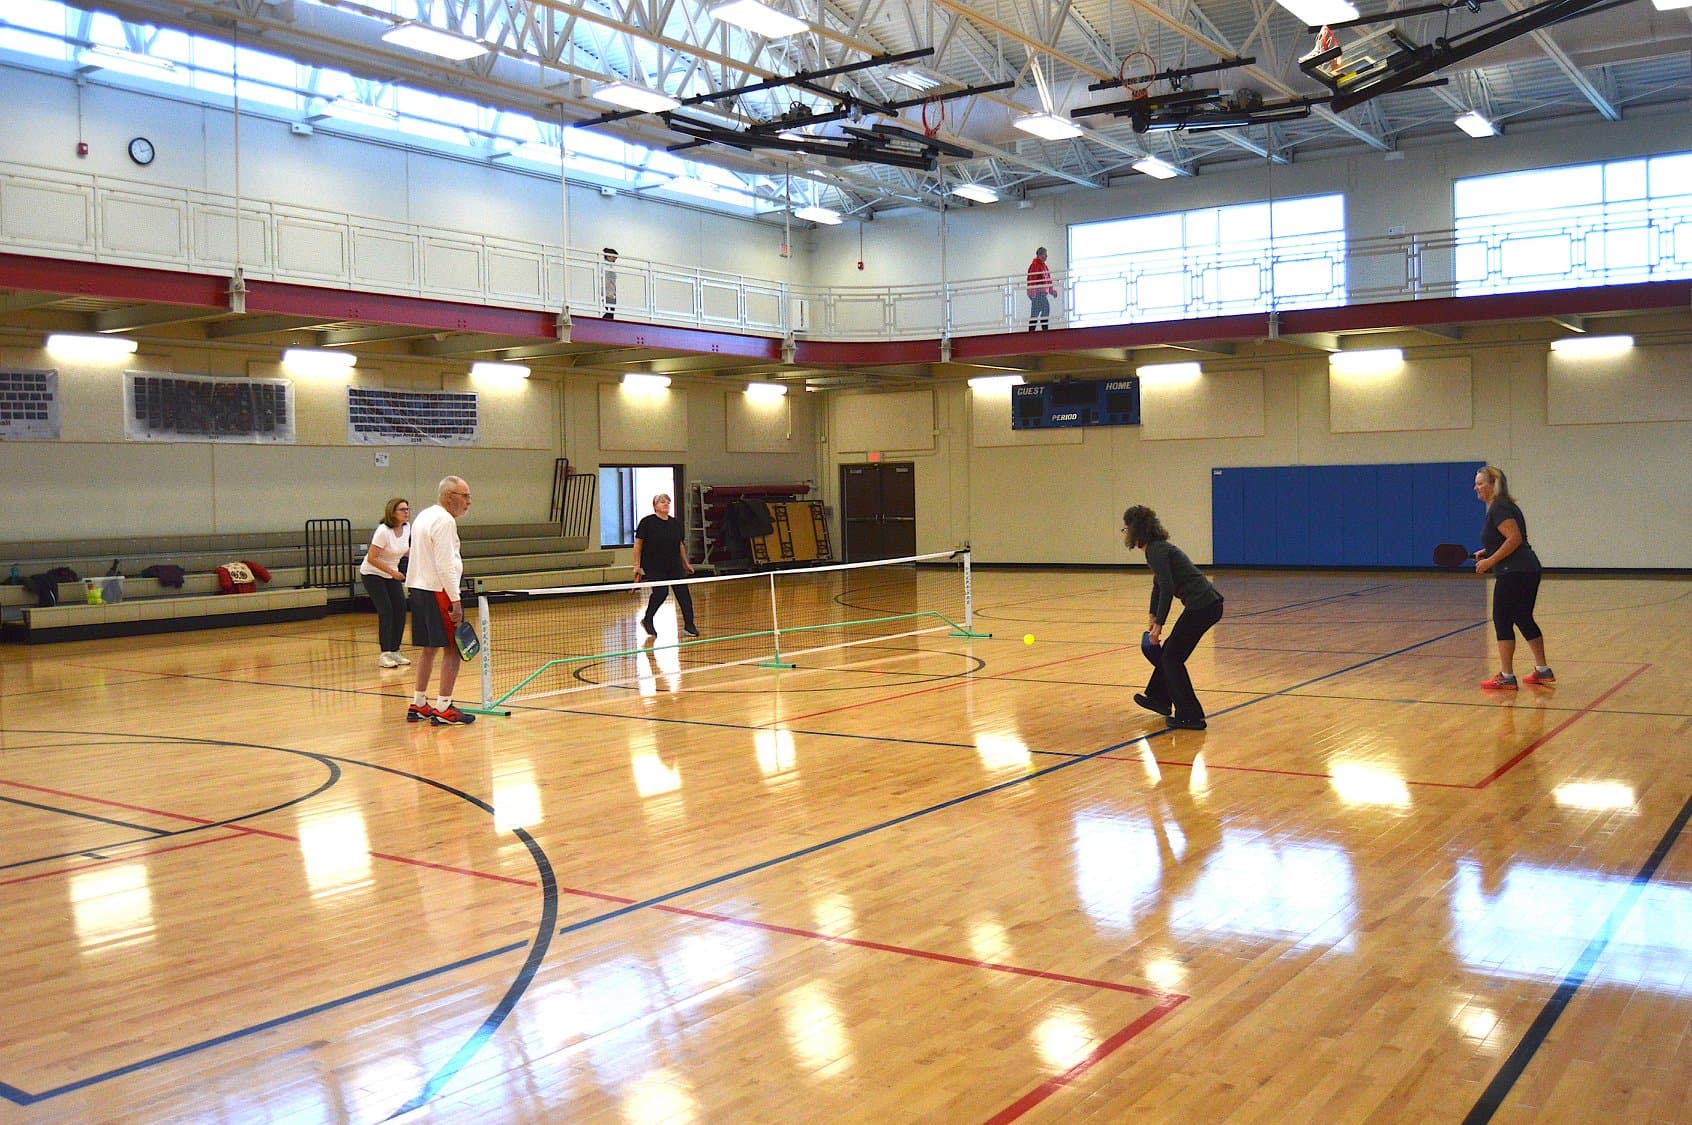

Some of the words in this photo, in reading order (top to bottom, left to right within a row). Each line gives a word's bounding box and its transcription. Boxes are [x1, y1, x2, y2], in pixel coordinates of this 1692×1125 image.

[1017, 386, 1045, 396] GUEST
[1106, 381, 1132, 391] HOME
[1052, 413, 1078, 421] PERIOD
